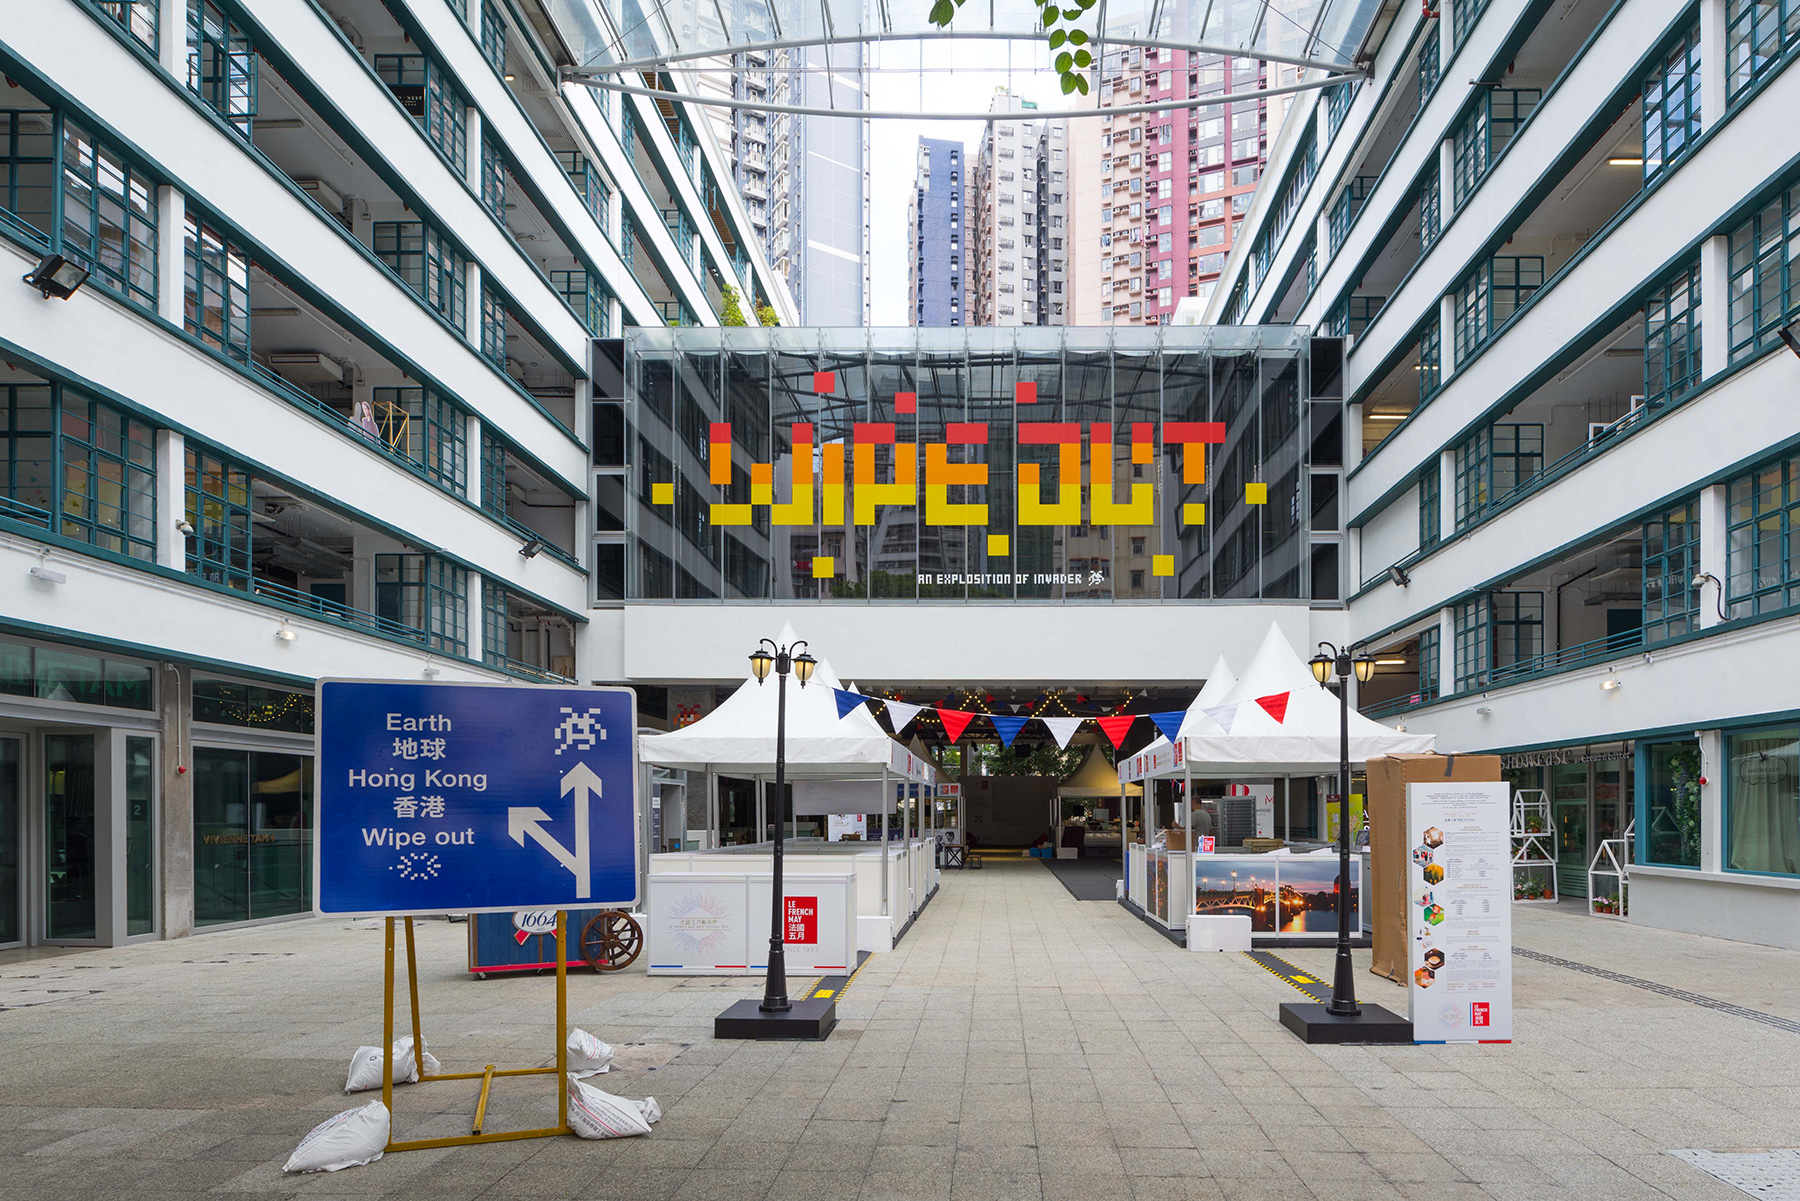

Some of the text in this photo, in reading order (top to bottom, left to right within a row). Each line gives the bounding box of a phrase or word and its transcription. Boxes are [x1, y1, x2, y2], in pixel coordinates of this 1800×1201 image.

[709, 423, 1225, 525] WIPE OUT
[917, 573, 1082, 584] AN EXPLOSITION OF INVADER
[386, 712, 452, 732] Earth
[392, 737, 447, 761] 地球
[349, 769, 488, 792] Hong Kong
[134, 804, 141, 815] 2
[393, 796, 446, 818] 香港
[203, 834, 249, 845] VIVIENNE
[361, 827, 475, 850] Wipe out
[788, 900, 796, 908] LE
[521, 910, 557, 927] 1664
[788, 908, 814, 916] FRENCH
[788, 923, 805, 932] 法國
[788, 932, 805, 940] 五月
